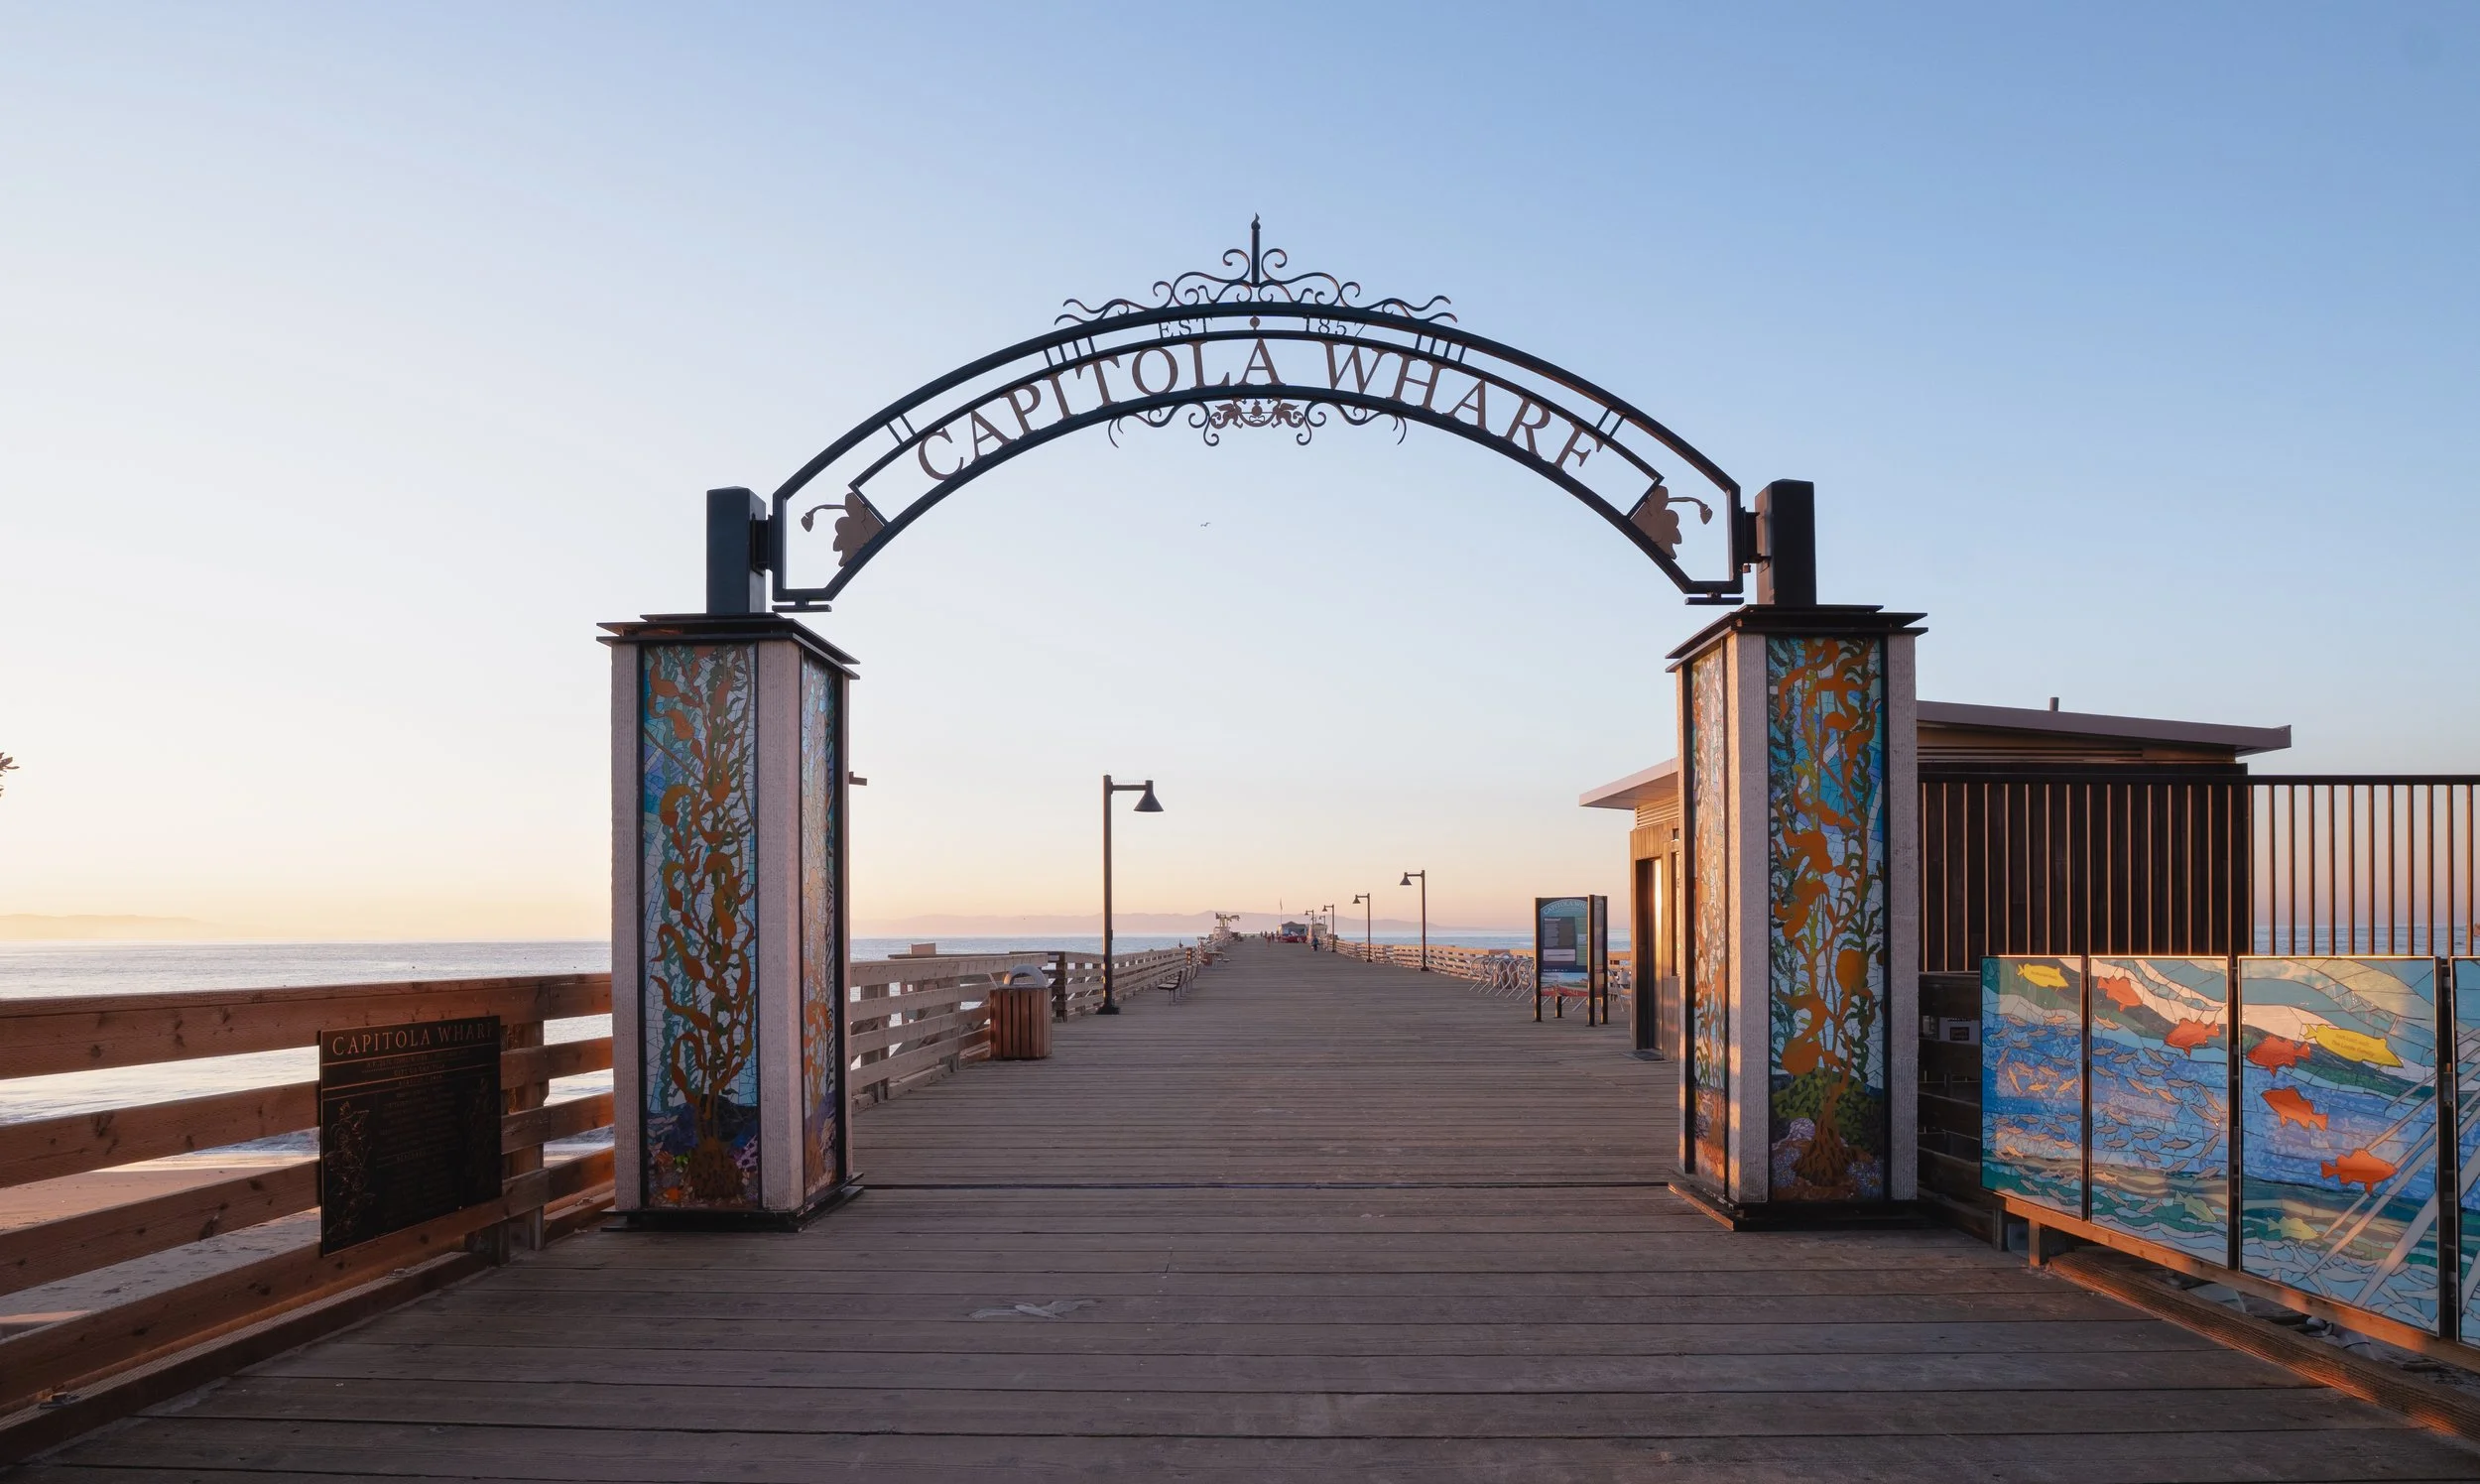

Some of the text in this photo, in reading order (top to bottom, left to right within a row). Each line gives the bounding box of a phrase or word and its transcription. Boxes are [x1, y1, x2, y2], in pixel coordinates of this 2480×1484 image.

[1158, 314, 1367, 339] EST 1857
[918, 337, 1605, 481] CAPITOLA WHARF
[1544, 901, 1573, 914] CAPITOLA
[332, 1022, 492, 1055] CAPITOLA WHARF
